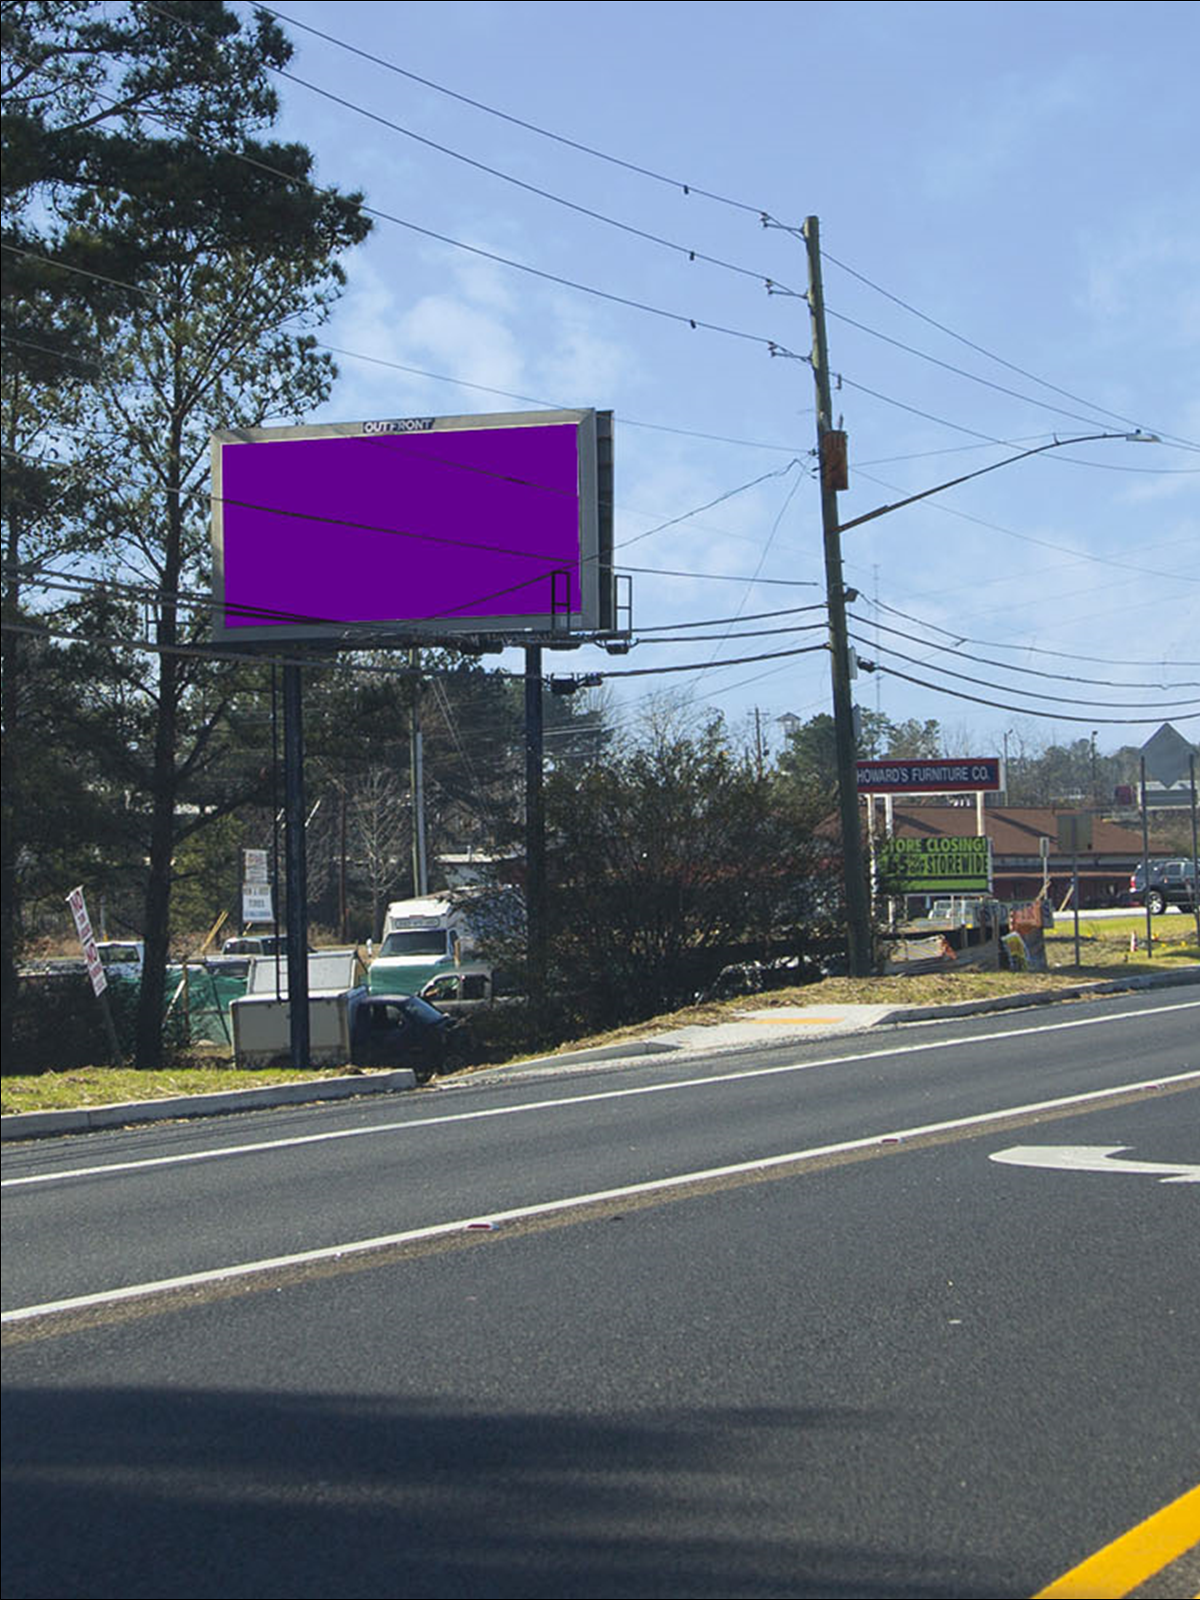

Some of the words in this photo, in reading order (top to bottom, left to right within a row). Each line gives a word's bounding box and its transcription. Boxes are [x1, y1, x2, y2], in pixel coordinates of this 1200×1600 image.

[364, 419, 433, 433] OUTFRONT
[857, 767, 909, 784] HOWARD'S
[912, 766, 969, 781] FURNITURE
[926, 837, 987, 853] CLOSING!
[926, 854, 988, 874] STOREWIDE
